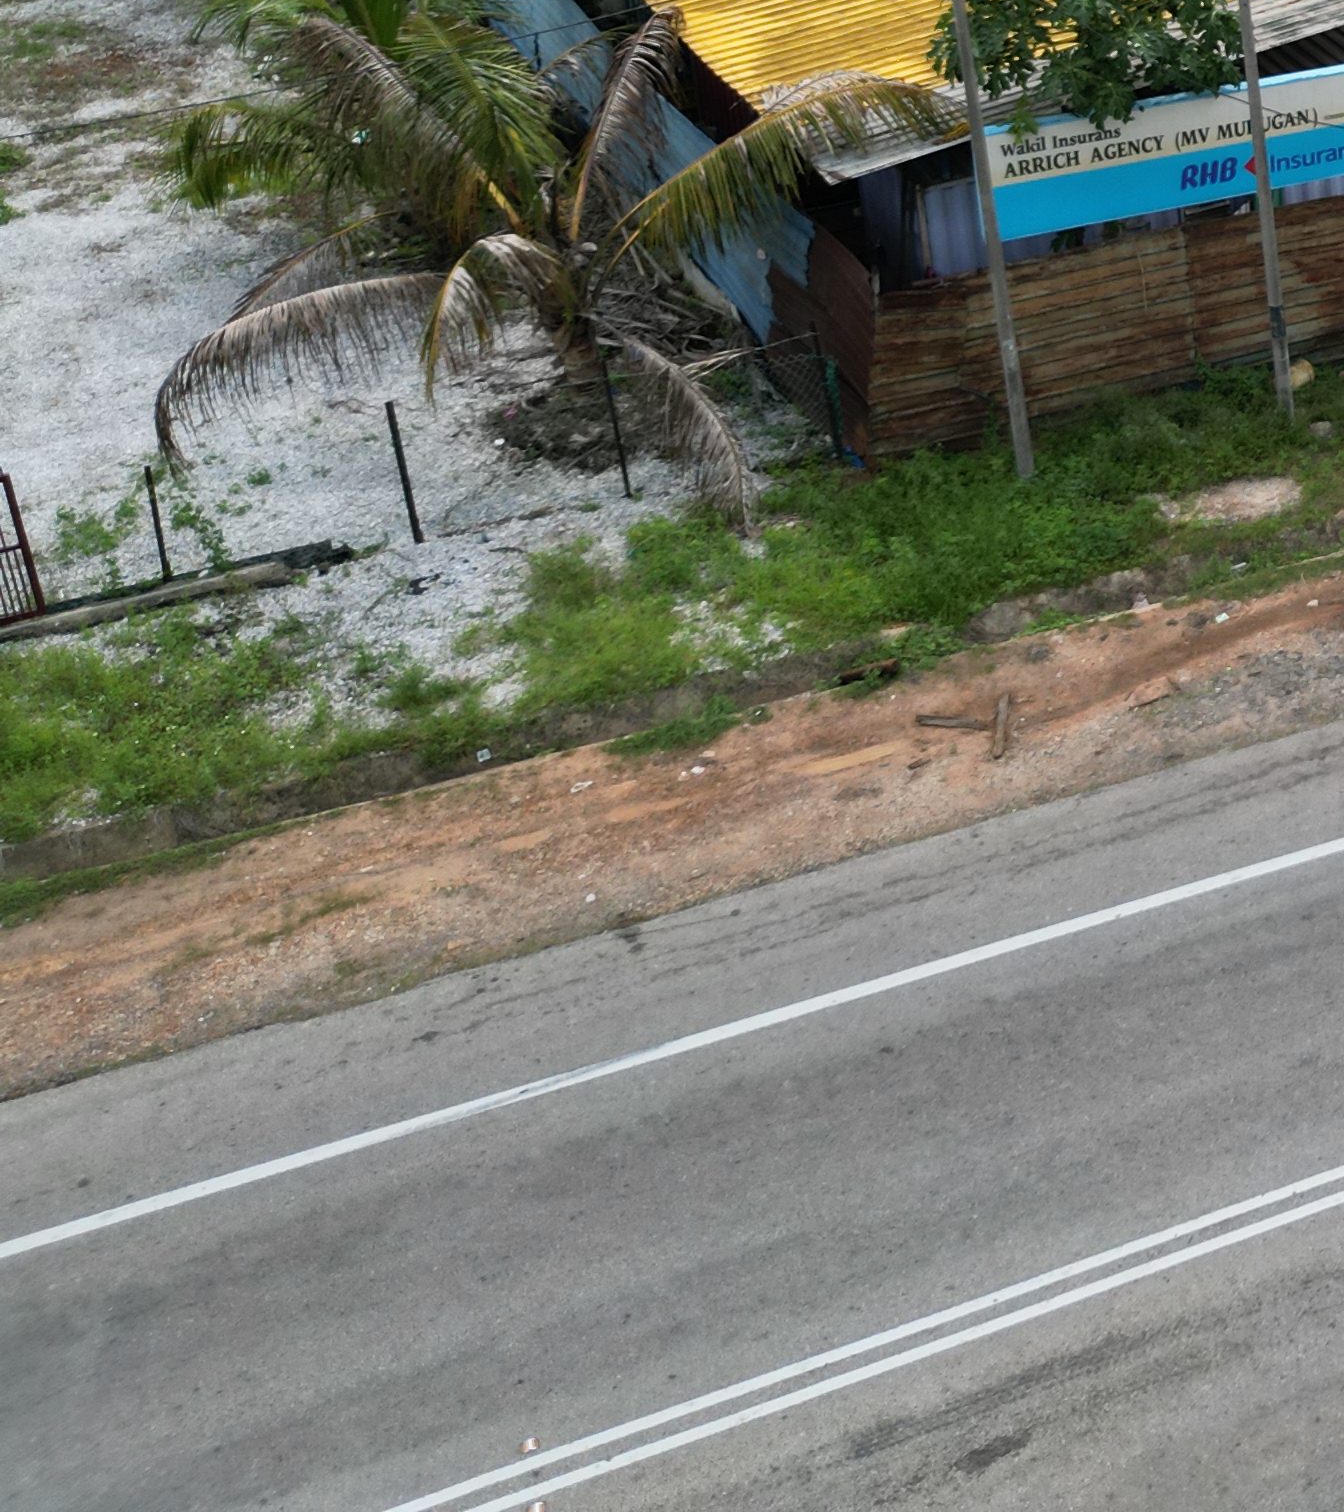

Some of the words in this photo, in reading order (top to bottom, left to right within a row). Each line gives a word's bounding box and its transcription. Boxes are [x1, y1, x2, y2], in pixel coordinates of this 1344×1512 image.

[1001, 135, 1046, 157] Wakil
[1052, 127, 1122, 148] Insurans
[1004, 149, 1081, 178] ARRICH
[1090, 134, 1165, 163] AGENCY
[1175, 126, 1210, 152] (MV
[1216, 107, 1318, 143] MUUGAN)
[1180, 155, 1238, 190] RHB
